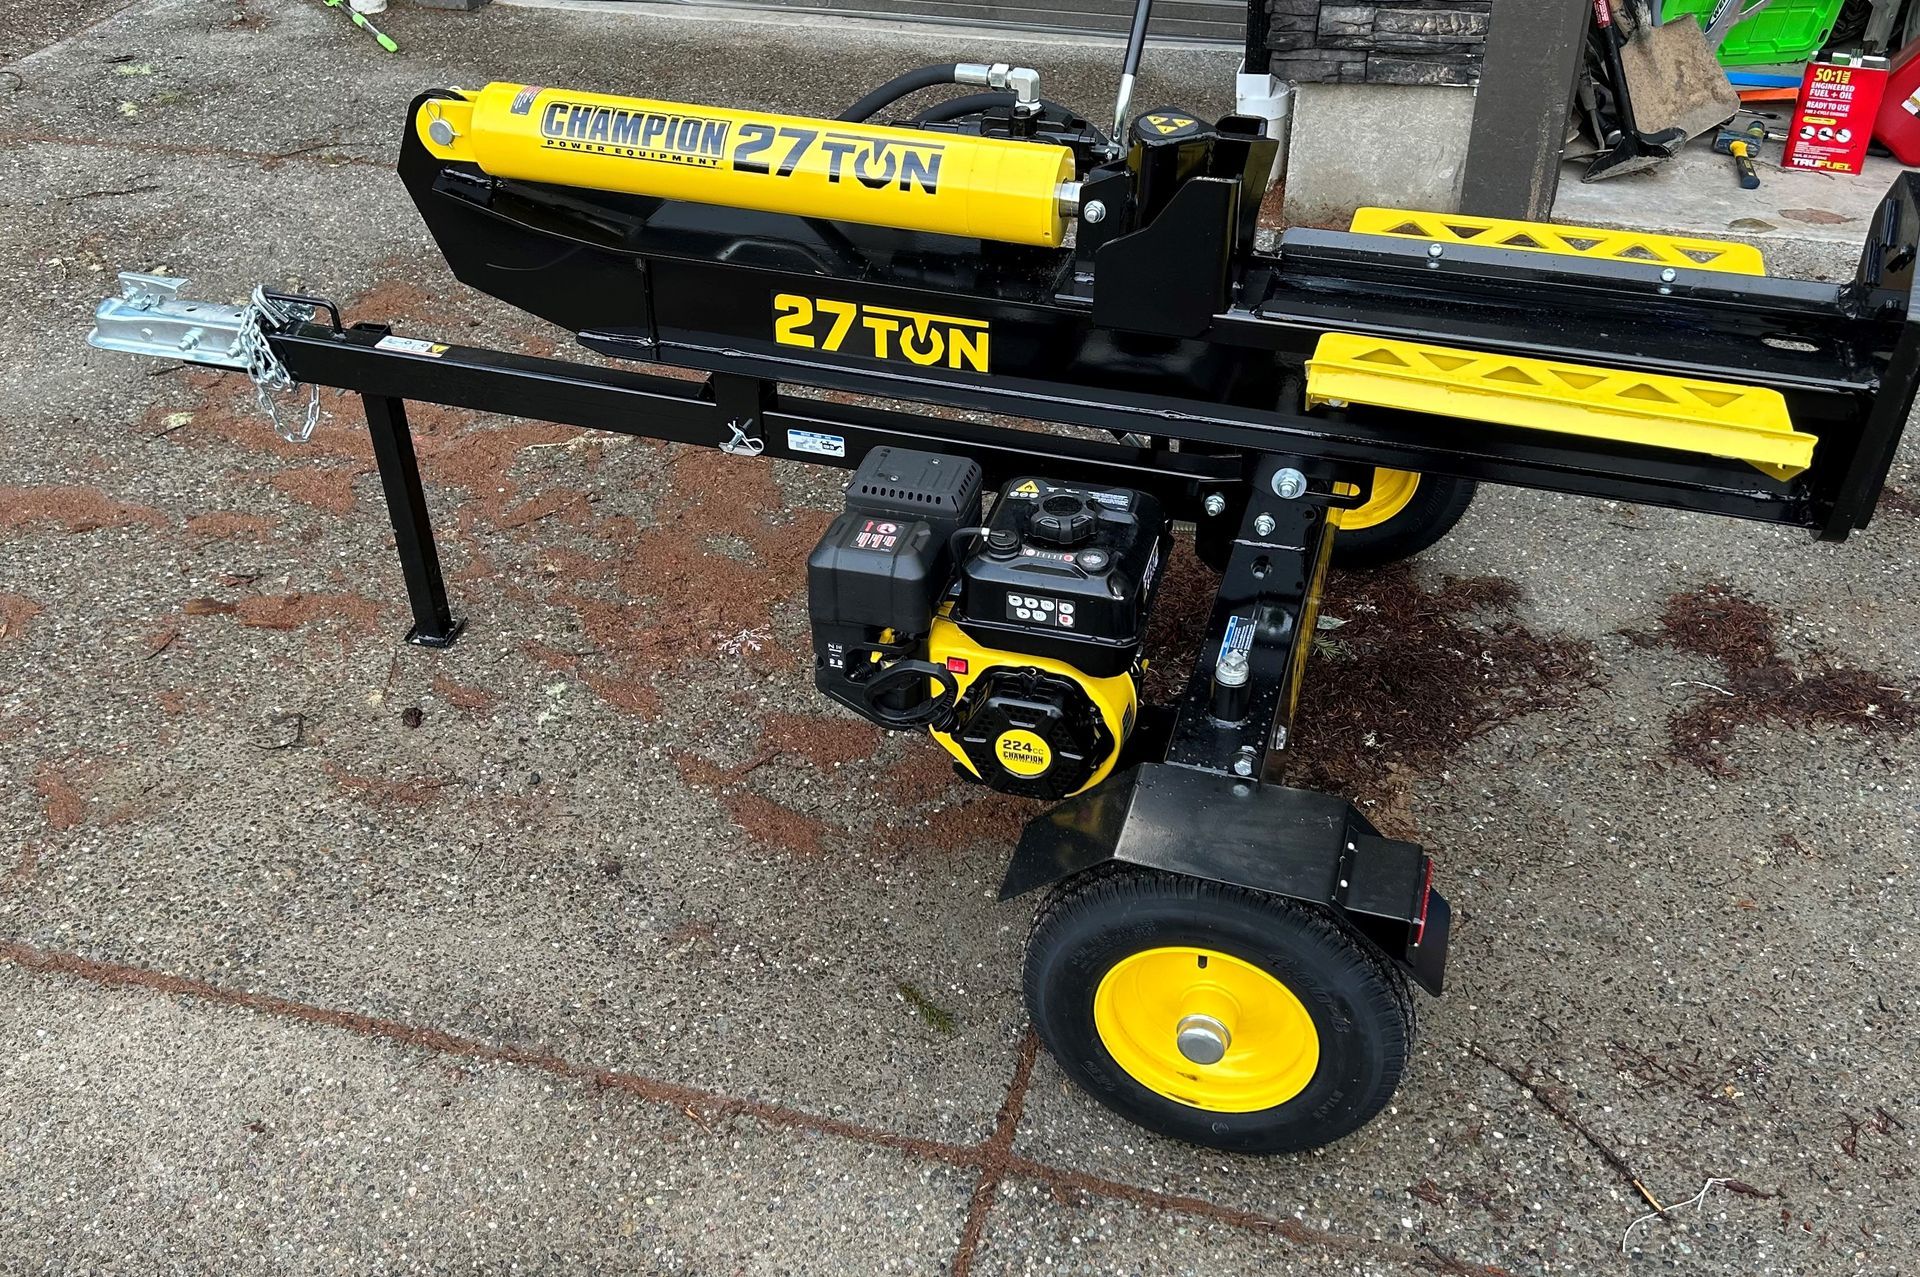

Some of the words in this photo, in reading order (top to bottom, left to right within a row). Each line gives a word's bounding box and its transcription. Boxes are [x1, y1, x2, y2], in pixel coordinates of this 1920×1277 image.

[1814, 68, 1843, 83] 50:1
[1841, 71, 1851, 84] MIX
[1811, 82, 1855, 92] ENGINEERED
[1809, 89, 1829, 97] FUEL
[1839, 91, 1852, 100] OIL
[1806, 101, 1827, 109] READY
[1837, 104, 1850, 112] USE
[544, 103, 727, 155] CHAMPION
[733, 123, 818, 177] 27
[821, 132, 945, 194] TON
[547, 139, 605, 153] POWER
[615, 147, 718, 166] EQUIPMENT
[1792, 157, 1852, 171] TRUFUEL
[774, 293, 857, 352] 27
[862, 304, 989, 373] TON
[1003, 739, 1032, 752] 224
[1003, 751, 1043, 764] CHAMPION
